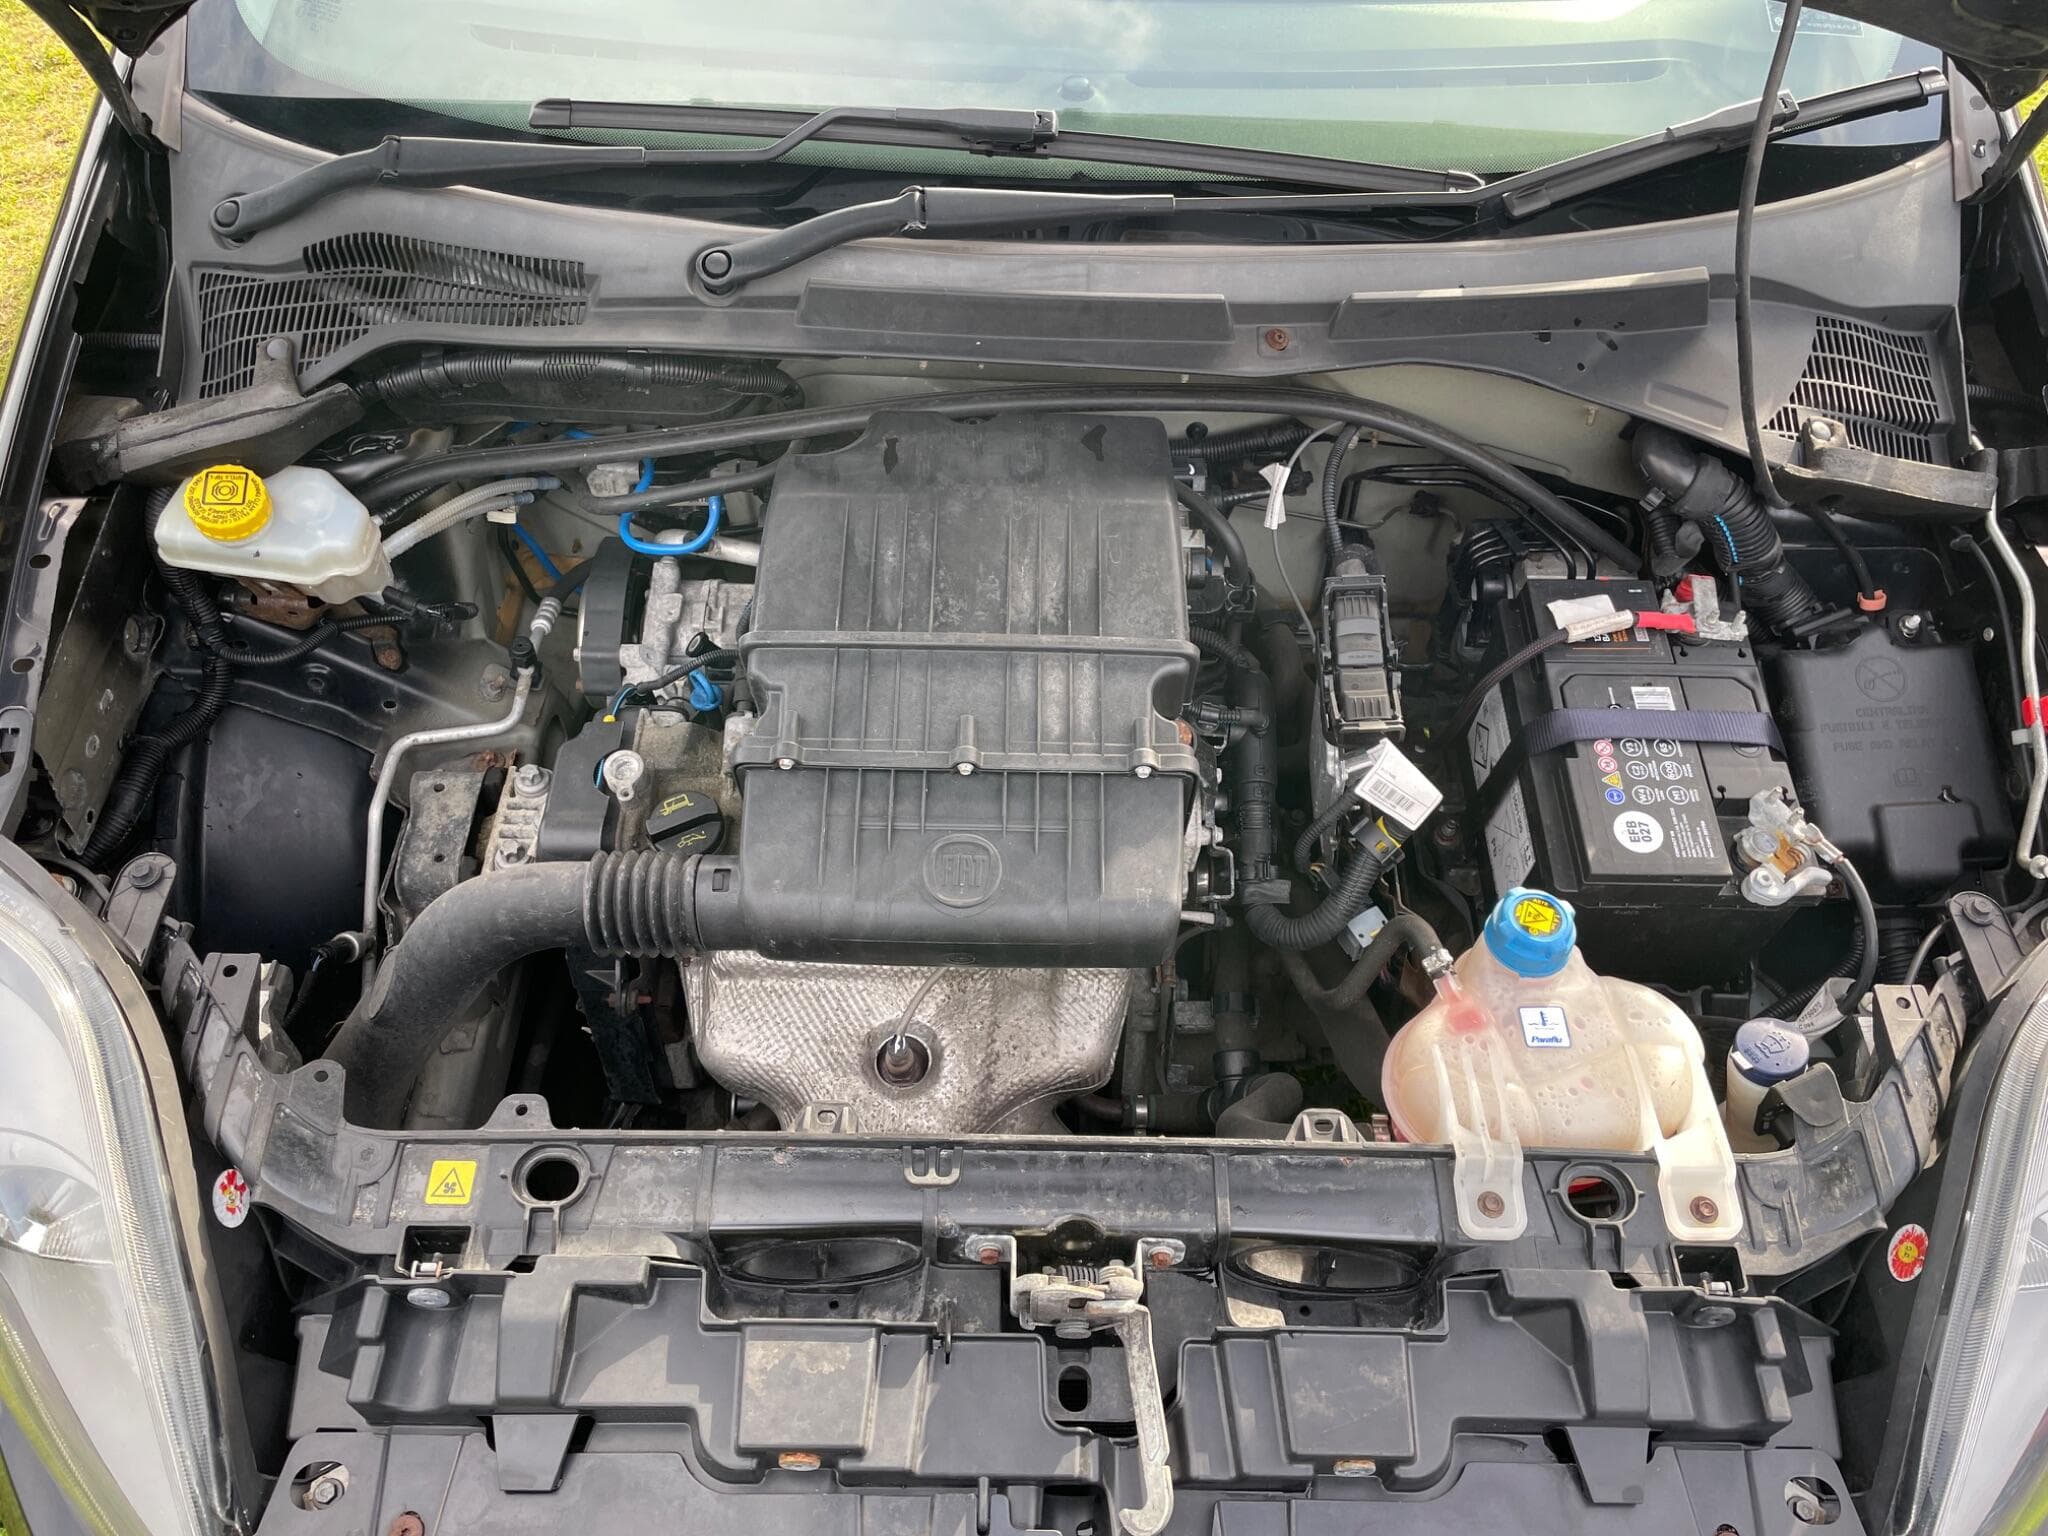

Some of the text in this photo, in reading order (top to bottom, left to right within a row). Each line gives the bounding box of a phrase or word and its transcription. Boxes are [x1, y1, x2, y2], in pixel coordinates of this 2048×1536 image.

[1625, 820, 1641, 843] EFB
[1637, 821, 1653, 843] 027
[942, 854, 987, 887] FIAT
